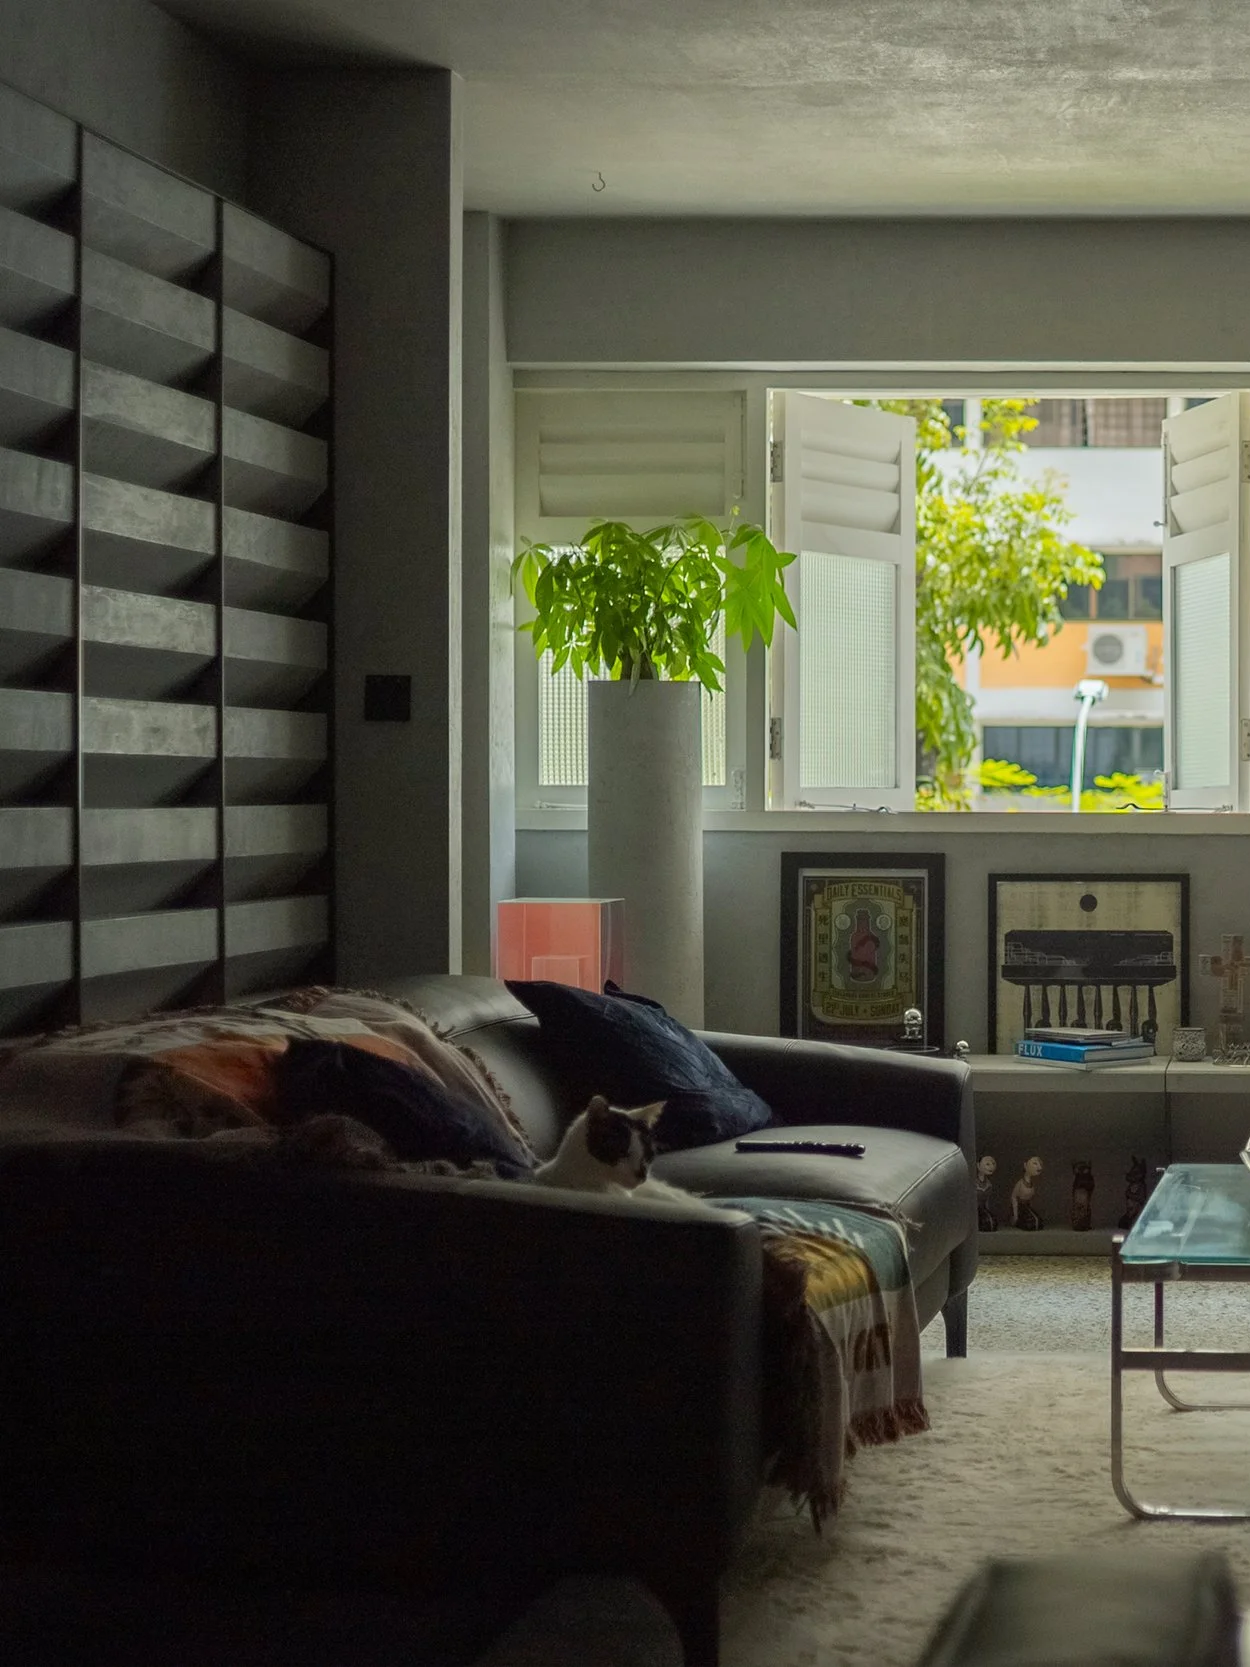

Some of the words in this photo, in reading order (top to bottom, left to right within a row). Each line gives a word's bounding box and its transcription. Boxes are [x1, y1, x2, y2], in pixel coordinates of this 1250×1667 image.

[826, 884, 849, 901] DAILY
[851, 883, 902, 901] ESSENTIALS
[1018, 1043, 1043, 1057] FLUX
